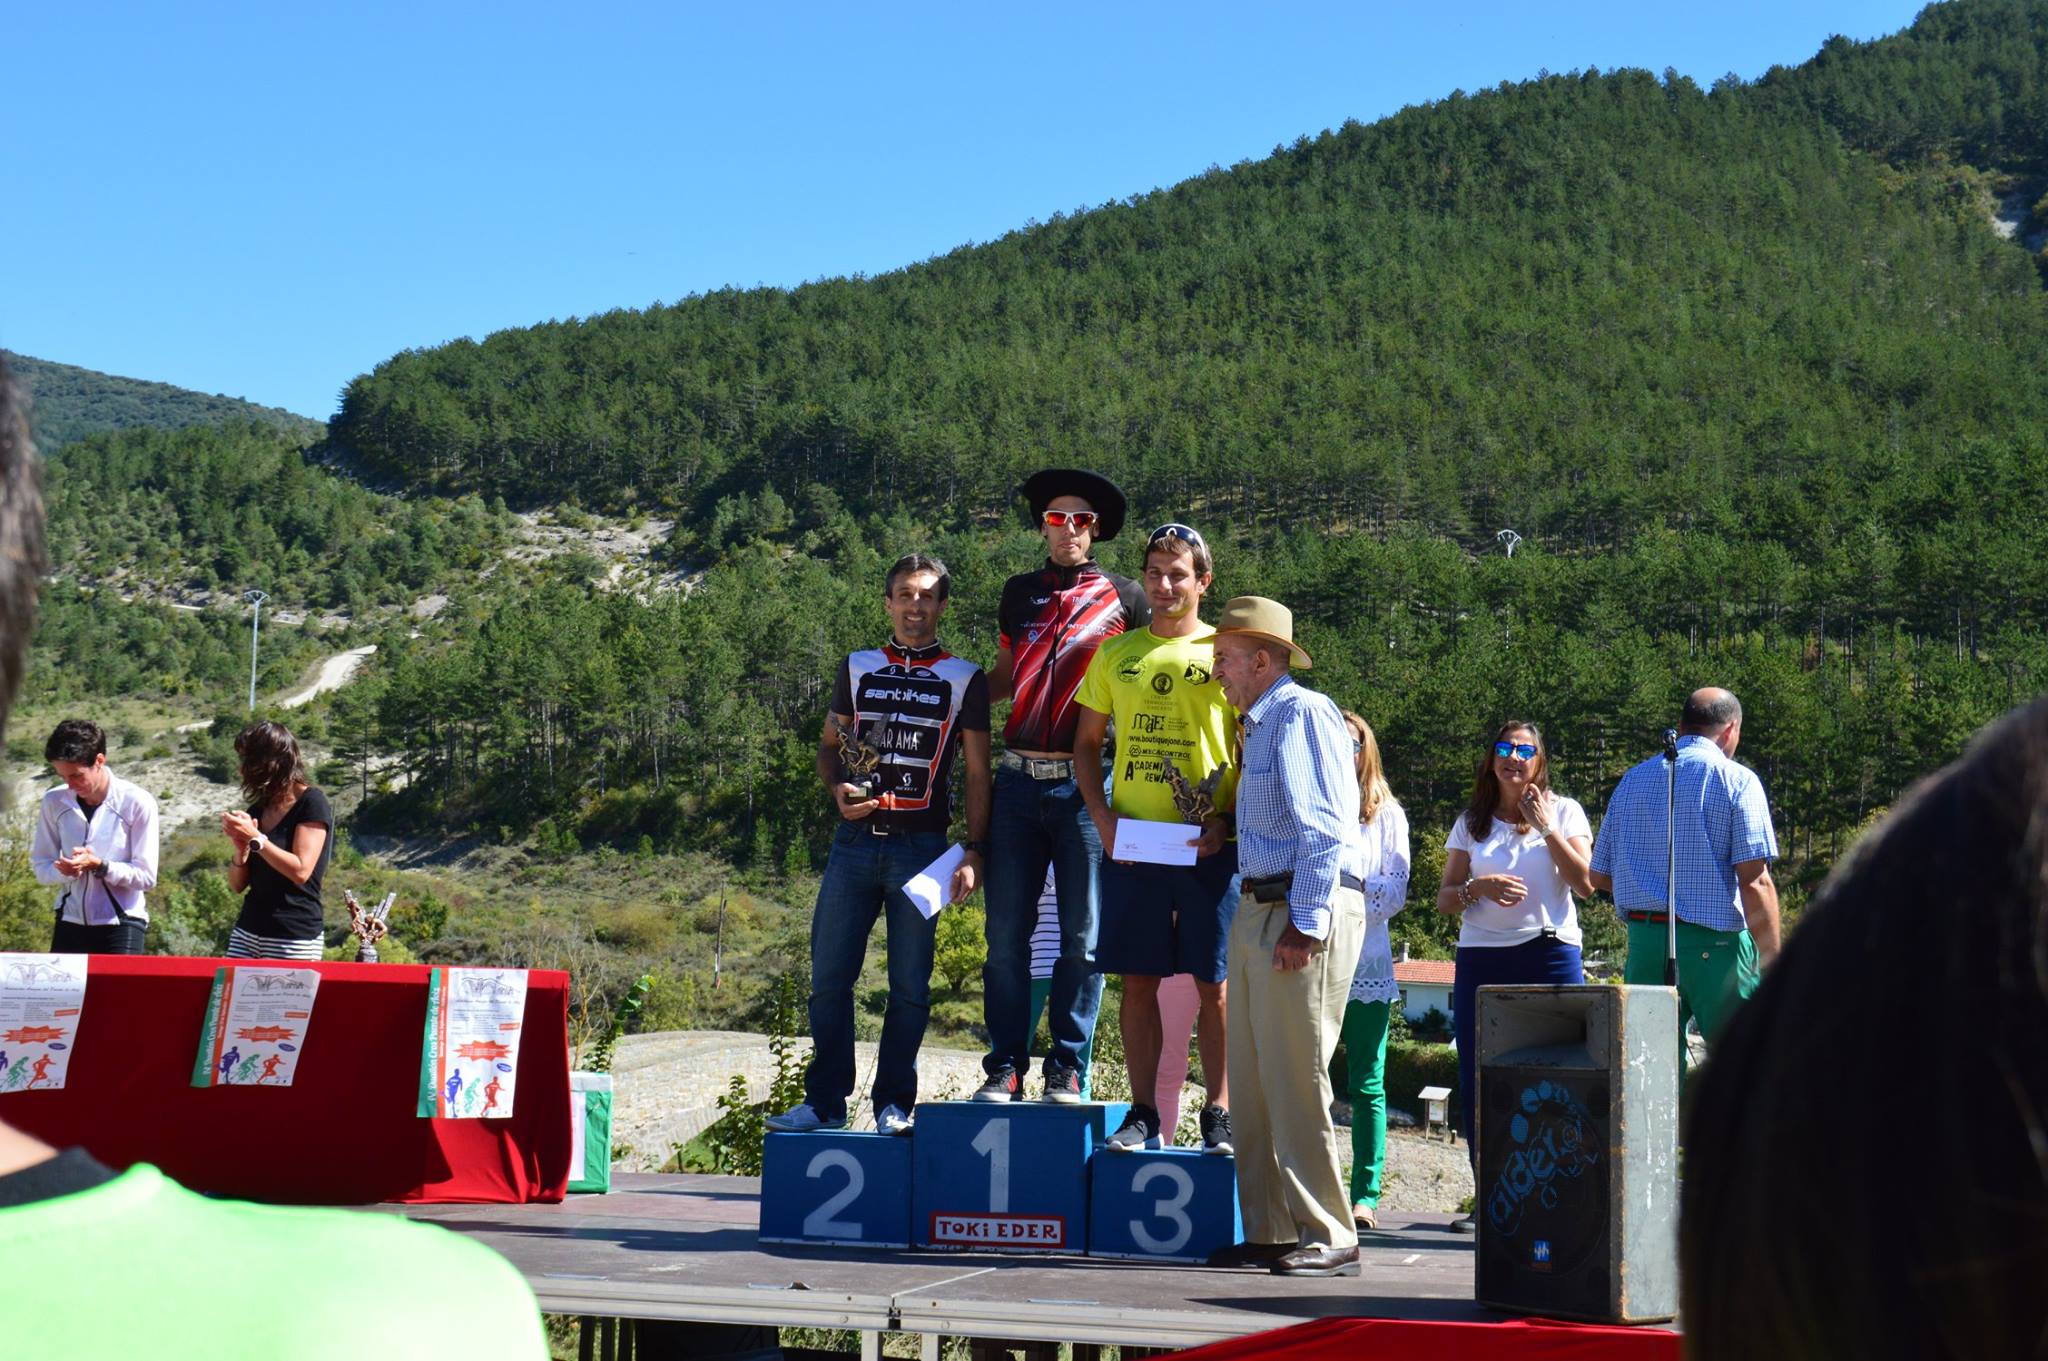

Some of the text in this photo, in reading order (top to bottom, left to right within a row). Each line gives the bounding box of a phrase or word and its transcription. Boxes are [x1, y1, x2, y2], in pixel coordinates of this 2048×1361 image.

[1125, 760, 1164, 781] ACADEMI
[803, 1149, 865, 1238] 2
[971, 1118, 1010, 1213] 1
[1129, 1162, 1194, 1254] 3
[997, 1223, 1057, 1239] EDER
